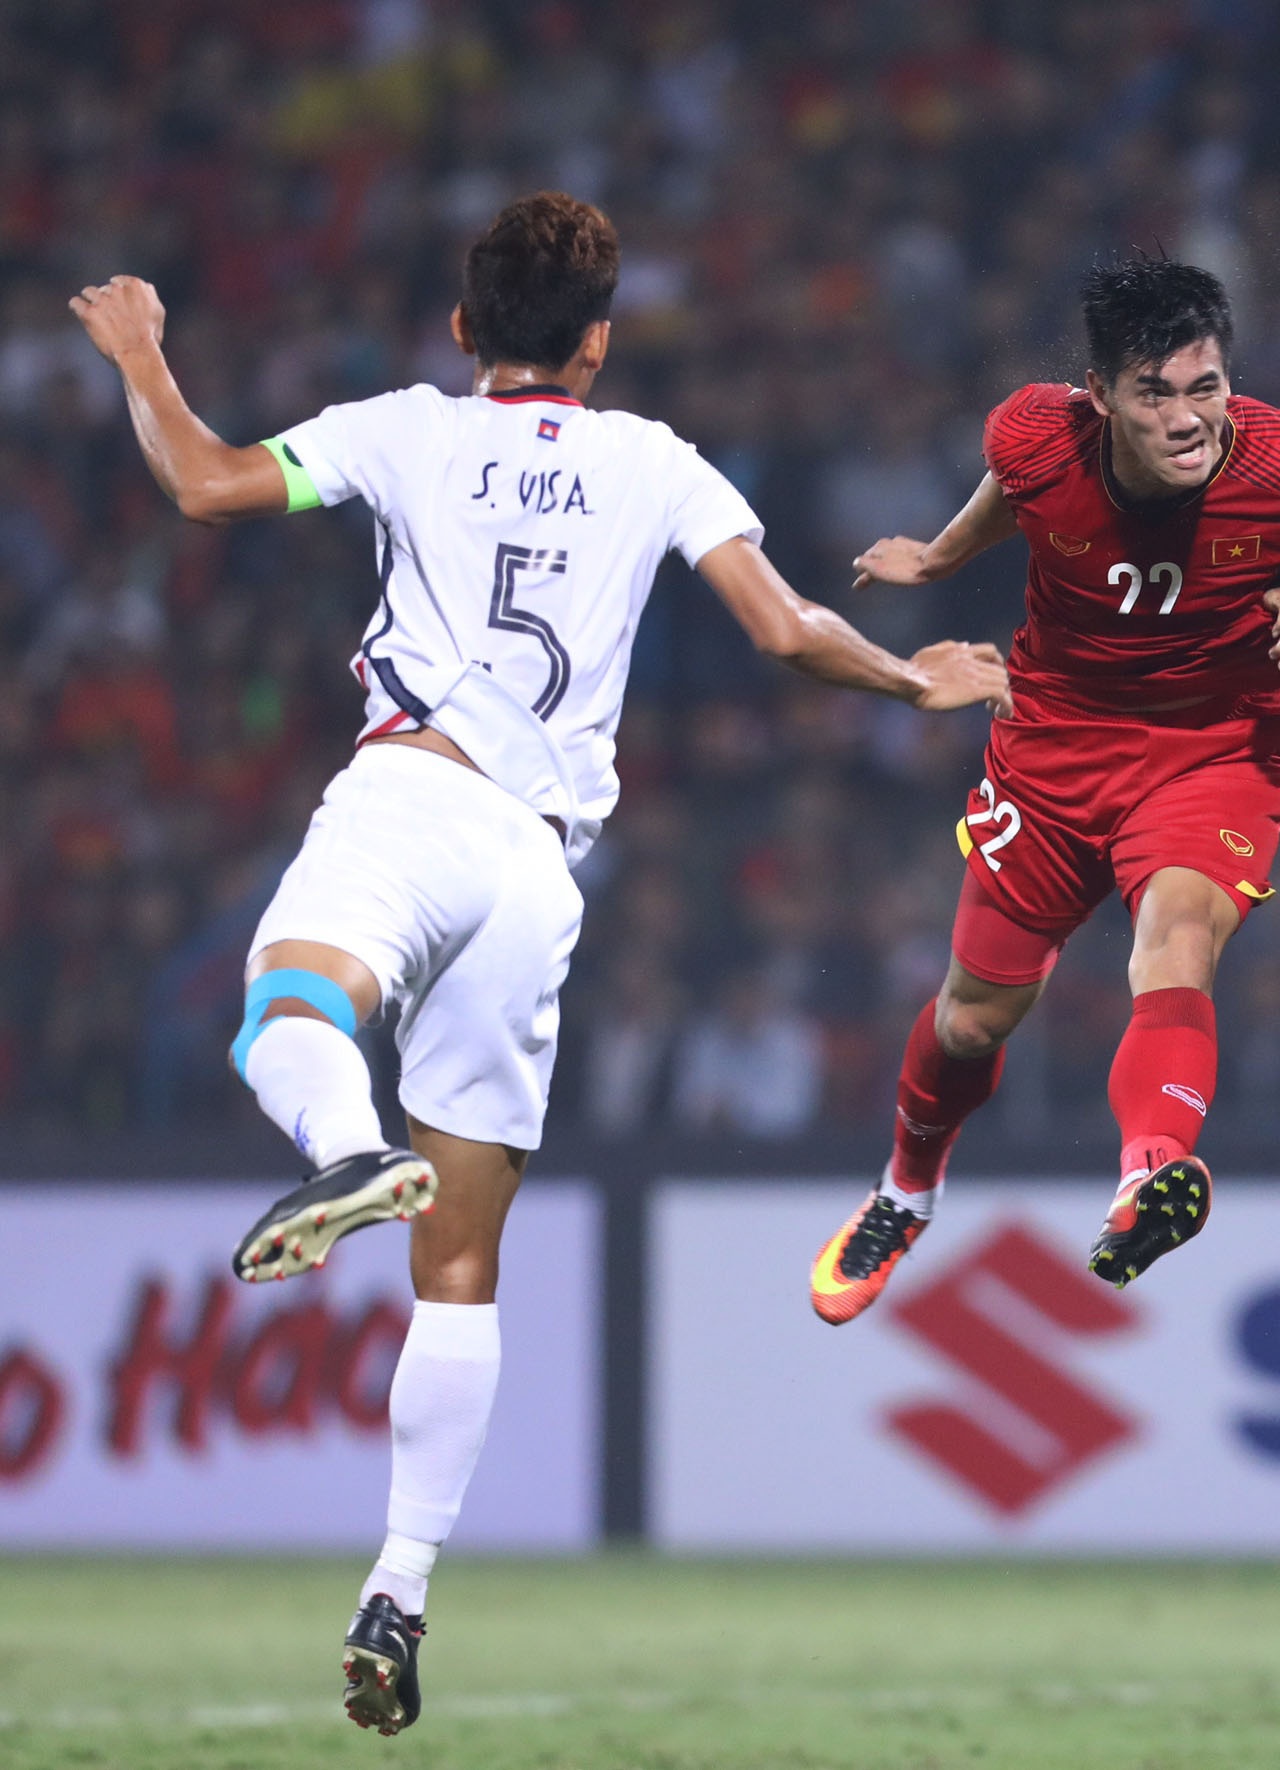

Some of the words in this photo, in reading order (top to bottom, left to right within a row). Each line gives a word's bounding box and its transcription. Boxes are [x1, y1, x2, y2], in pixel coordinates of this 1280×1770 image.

[471, 461, 499, 508] S.
[519, 469, 595, 514] VISA
[1107, 561, 1183, 615] 22
[472, 541, 572, 724] 5
[966, 777, 1021, 872] 22
